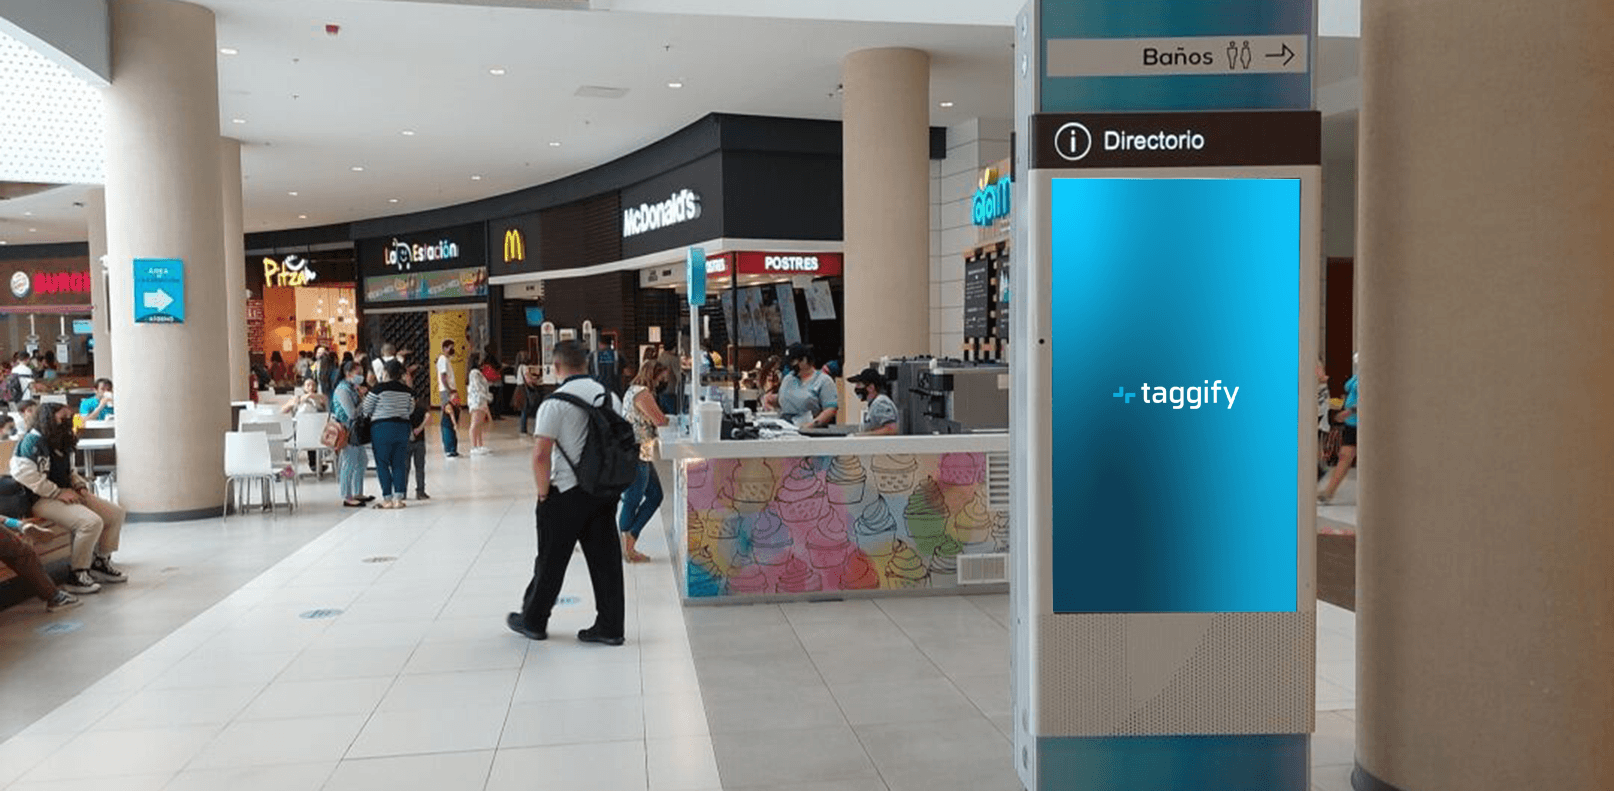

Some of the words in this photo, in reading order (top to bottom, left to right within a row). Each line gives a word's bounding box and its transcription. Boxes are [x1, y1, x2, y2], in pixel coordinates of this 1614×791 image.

[1143, 46, 1213, 65] Baños
[1104, 129, 1205, 150] Directorio
[623, 189, 698, 237] McDonald's
[385, 247, 397, 265] La
[412, 240, 459, 262] Estación
[764, 256, 819, 271] POSTRES
[1141, 380, 1240, 409] taggify
